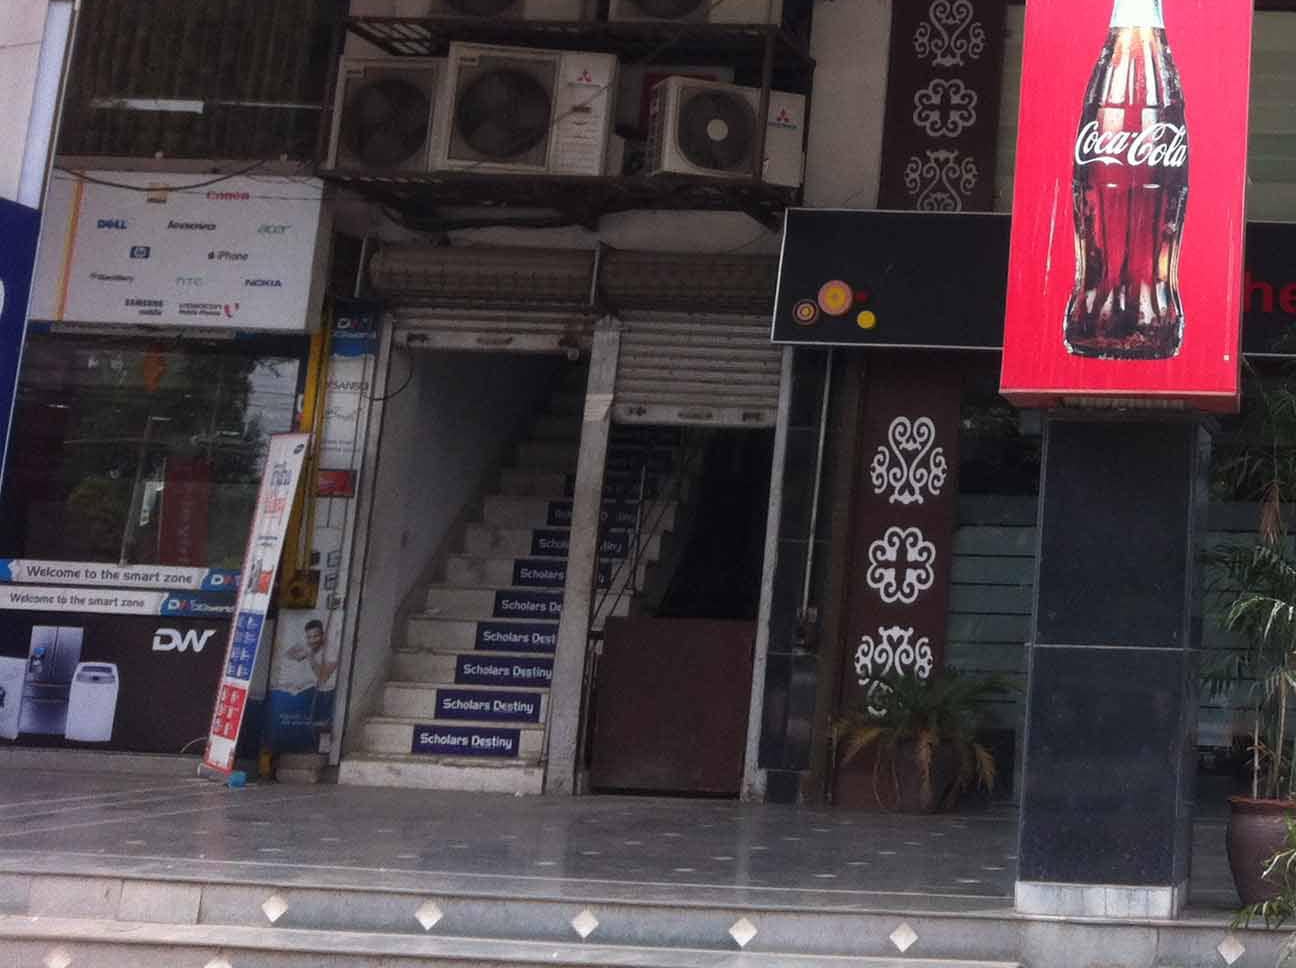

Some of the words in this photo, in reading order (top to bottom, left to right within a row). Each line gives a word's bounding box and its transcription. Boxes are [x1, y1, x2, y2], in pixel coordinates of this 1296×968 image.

[1074, 120, 1188, 168] Coca-Cola
[245, 278, 282, 288] NOKIA
[26, 565, 81, 579] Welcome
[84, 566, 97, 579] to
[101, 569, 120, 581] the
[123, 570, 159, 583] smart
[163, 573, 193, 584] zone
[519, 567, 565, 582] Scholars
[9, 591, 54, 604] Welcome
[56, 595, 67, 606] to
[69, 595, 85, 606] the
[87, 596, 118, 607] smart
[121, 598, 145, 609] zone
[501, 598, 547, 614] Scholars
[482, 630, 530, 646] Scholars
[462, 663, 510, 678] Scholars
[512, 666, 553, 682] Destiny
[442, 697, 491, 713] Scholars
[493, 700, 535, 715] Destiny
[420, 731, 470, 747] Scholars
[471, 734, 514, 751] Destiny
